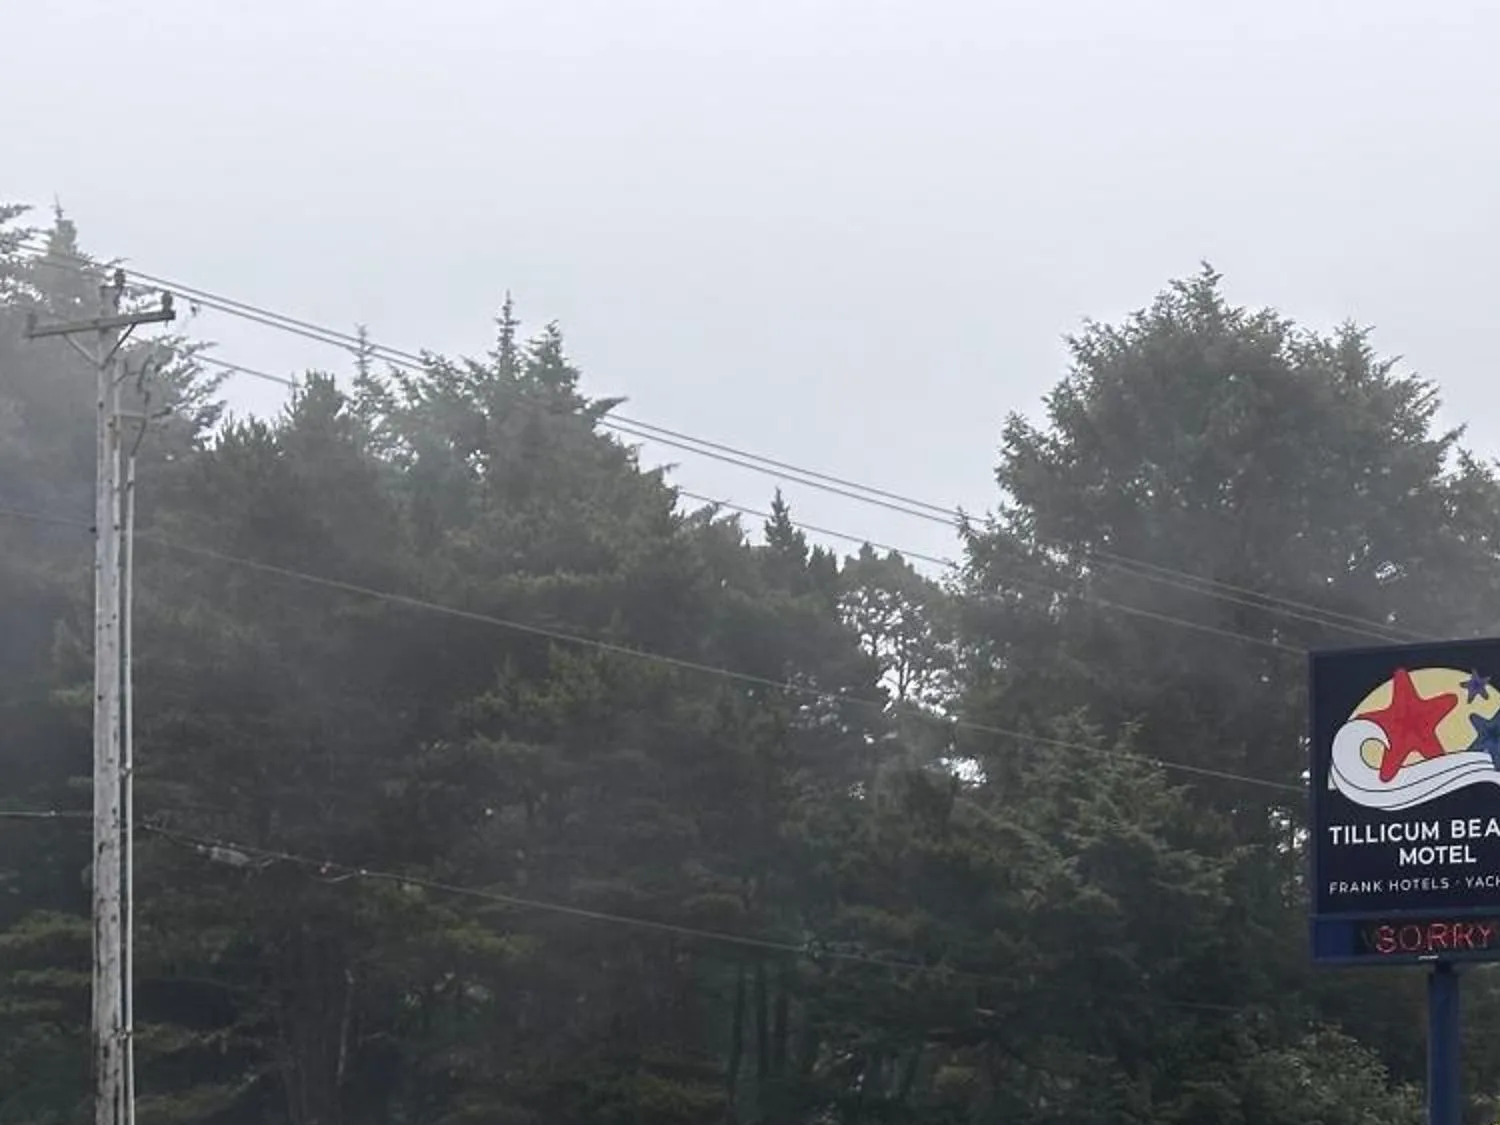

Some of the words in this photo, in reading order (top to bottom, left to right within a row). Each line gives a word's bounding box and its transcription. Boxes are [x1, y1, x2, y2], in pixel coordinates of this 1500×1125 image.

[1328, 820, 1440, 845] TILLICUM
[1399, 845, 1477, 866] MOTEL
[1329, 879, 1383, 895] FRANK
[1389, 876, 1450, 892] HOTELS
[1375, 923, 1491, 953] SORRY
